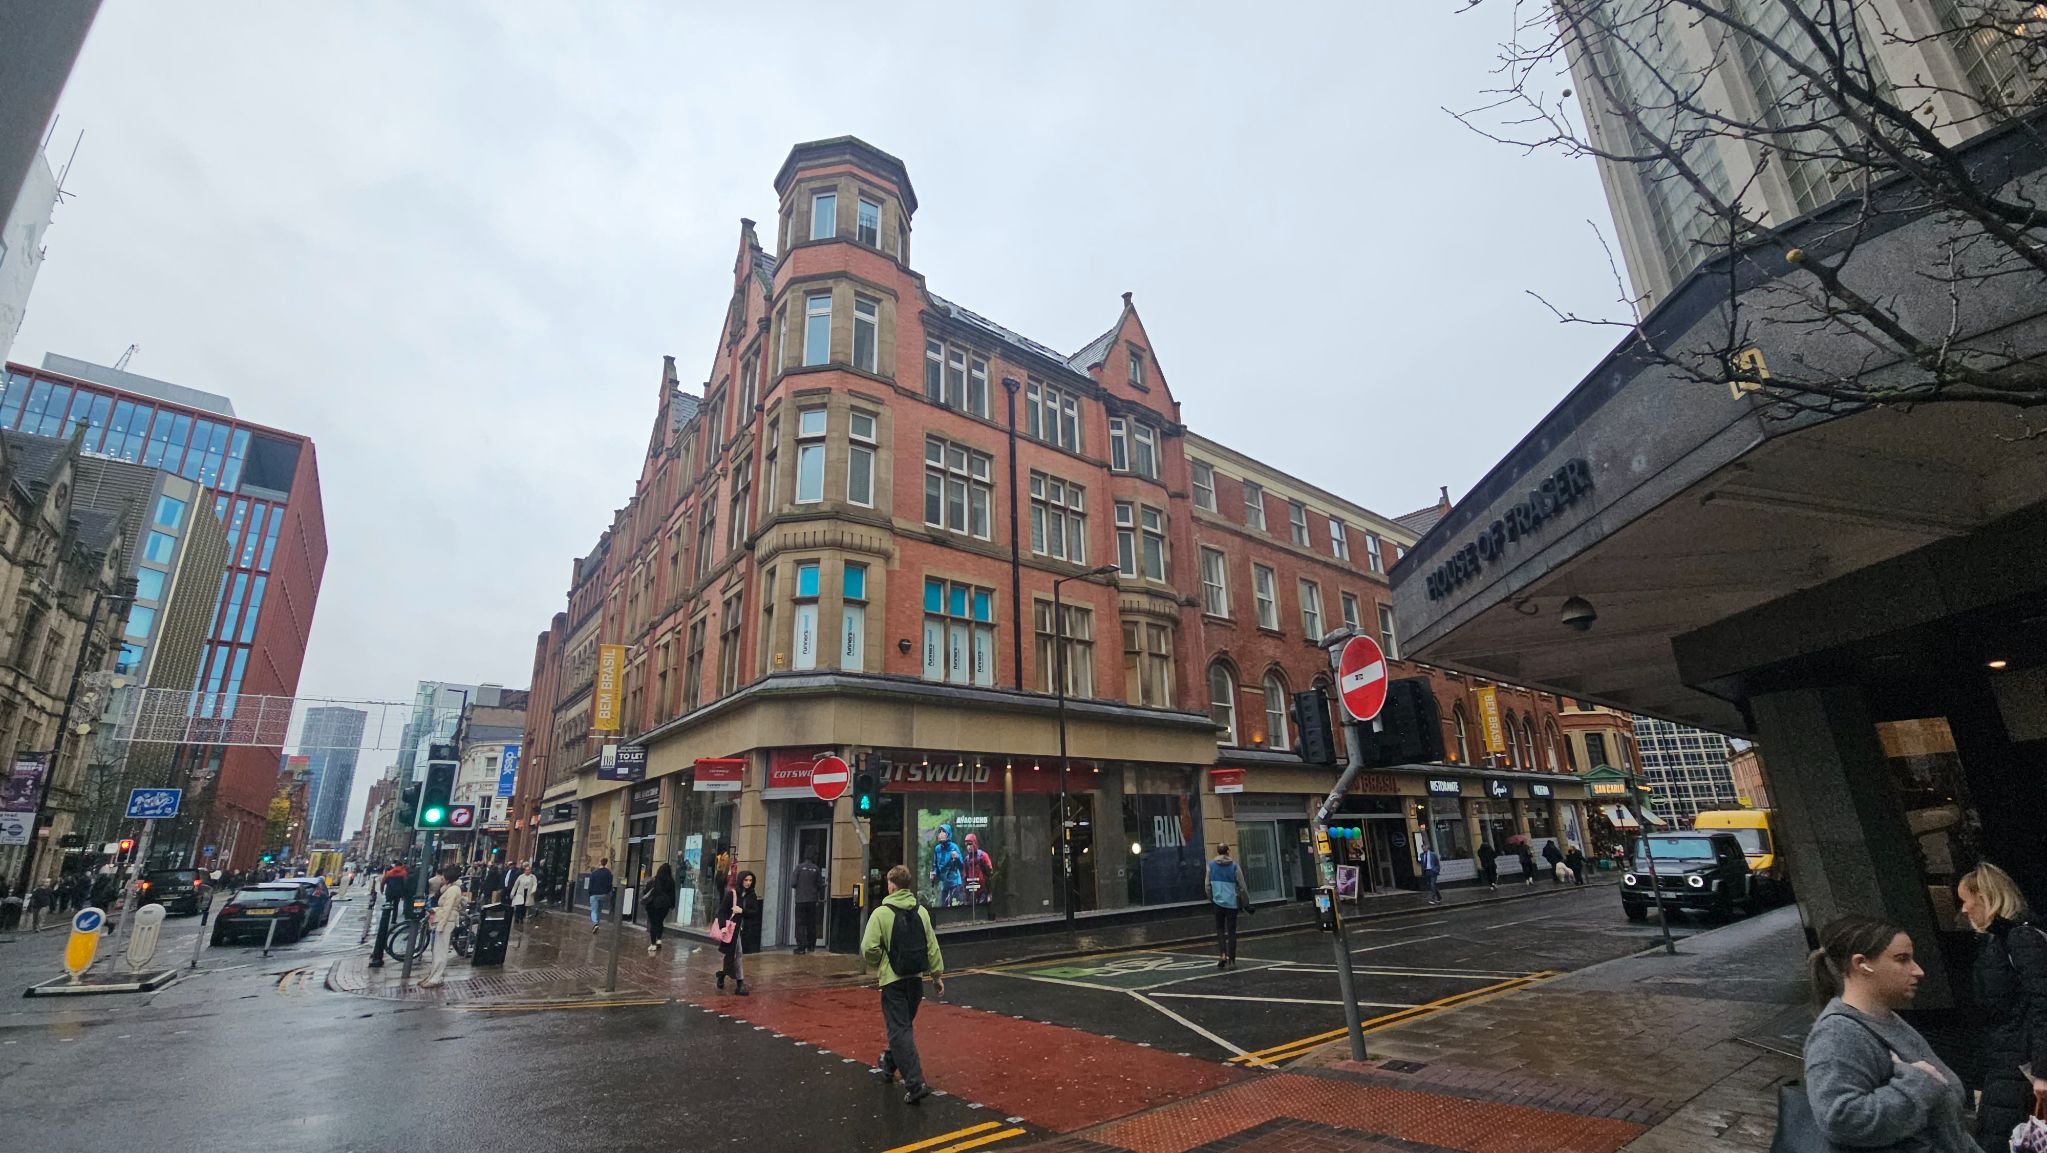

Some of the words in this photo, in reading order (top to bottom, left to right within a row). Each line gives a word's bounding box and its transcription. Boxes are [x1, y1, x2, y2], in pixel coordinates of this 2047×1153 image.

[1426, 543, 1481, 601] HOUSE
[1477, 520, 1506, 562] OF
[1503, 458, 1595, 544] FRASER
[601, 648, 616, 690] BRASIL
[598, 695, 612, 719] BEM
[1484, 695, 1496, 714] BEM
[1488, 716, 1502, 748] BRASIL
[503, 751, 517, 775] desk
[631, 752, 645, 760] LET
[879, 760, 991, 783] OTSWOLD
[1594, 784, 1608, 794] SAN
[1607, 784, 1625, 794] CARLO
[1153, 815, 1186, 848] RUN
